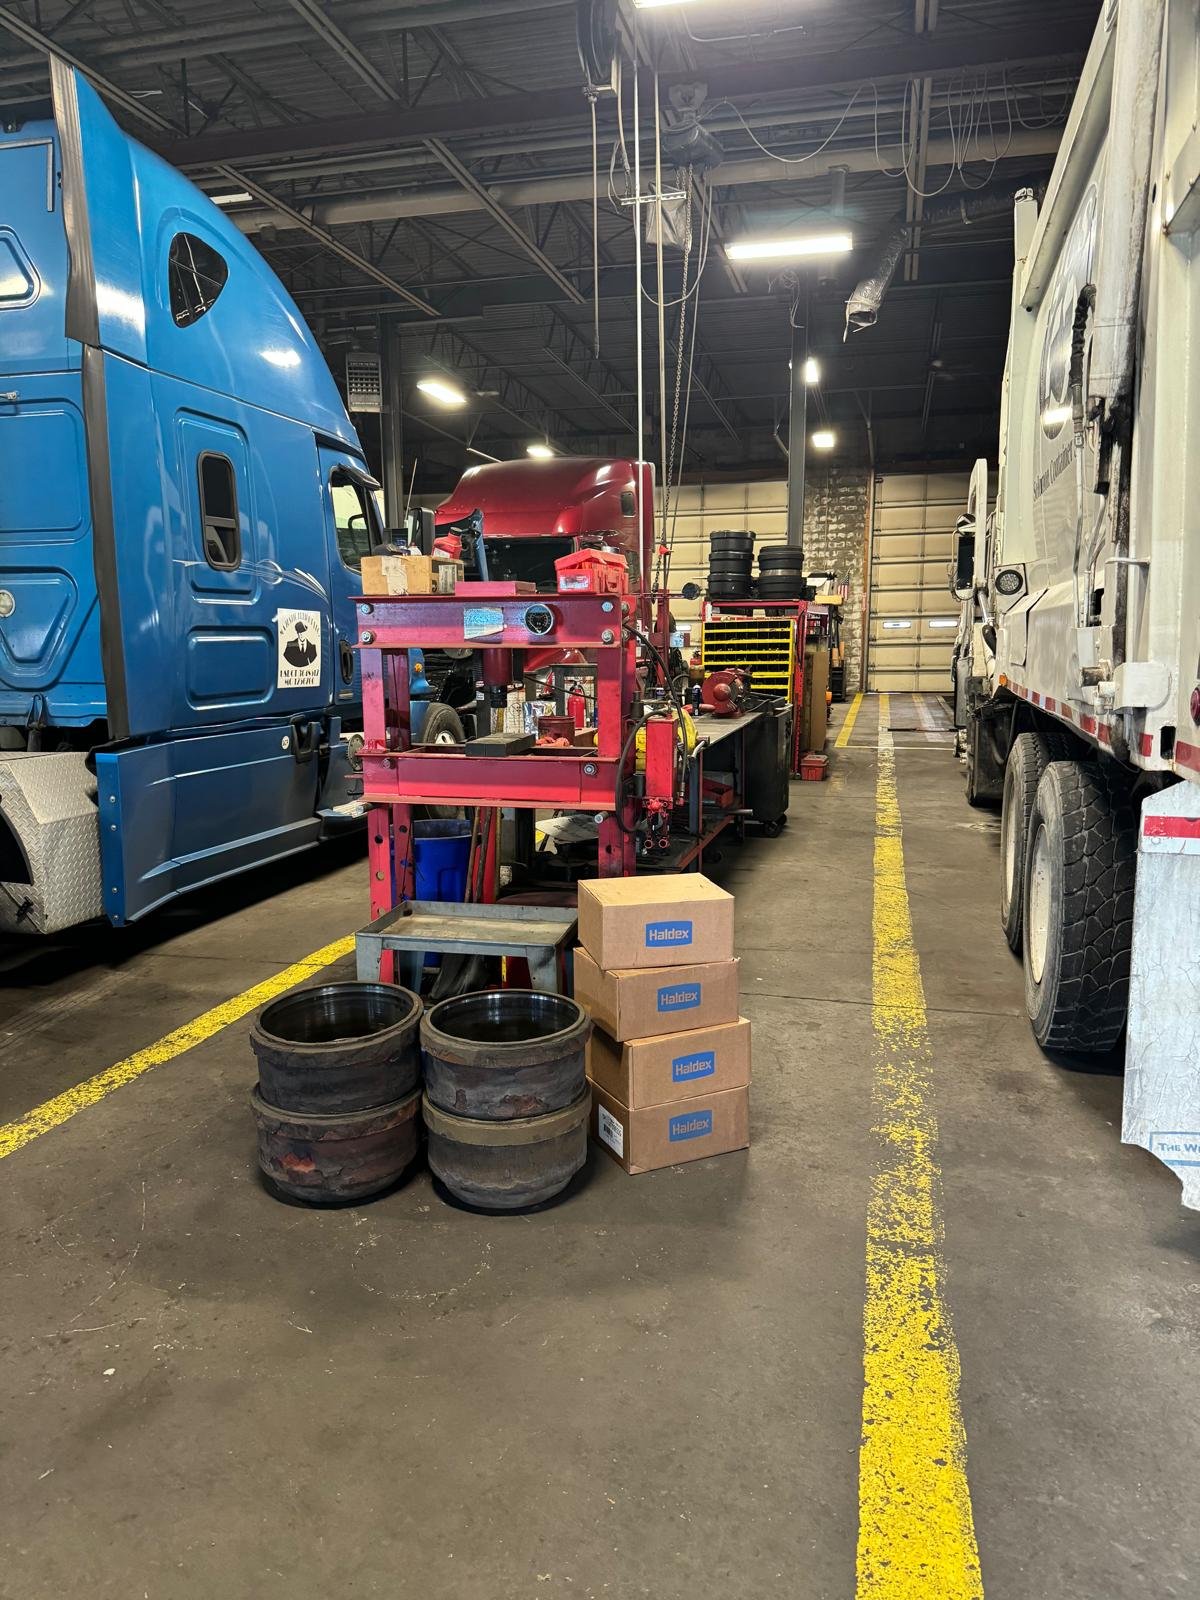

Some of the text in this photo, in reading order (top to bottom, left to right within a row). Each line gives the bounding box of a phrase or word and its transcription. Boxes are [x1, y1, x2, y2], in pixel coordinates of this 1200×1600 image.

[649, 928, 689, 941] Haldex
[661, 991, 698, 1006] Haldex
[675, 1060, 712, 1076] Haldex
[672, 1118, 709, 1135] Haldex
[1157, 1142, 1181, 1151] THE
